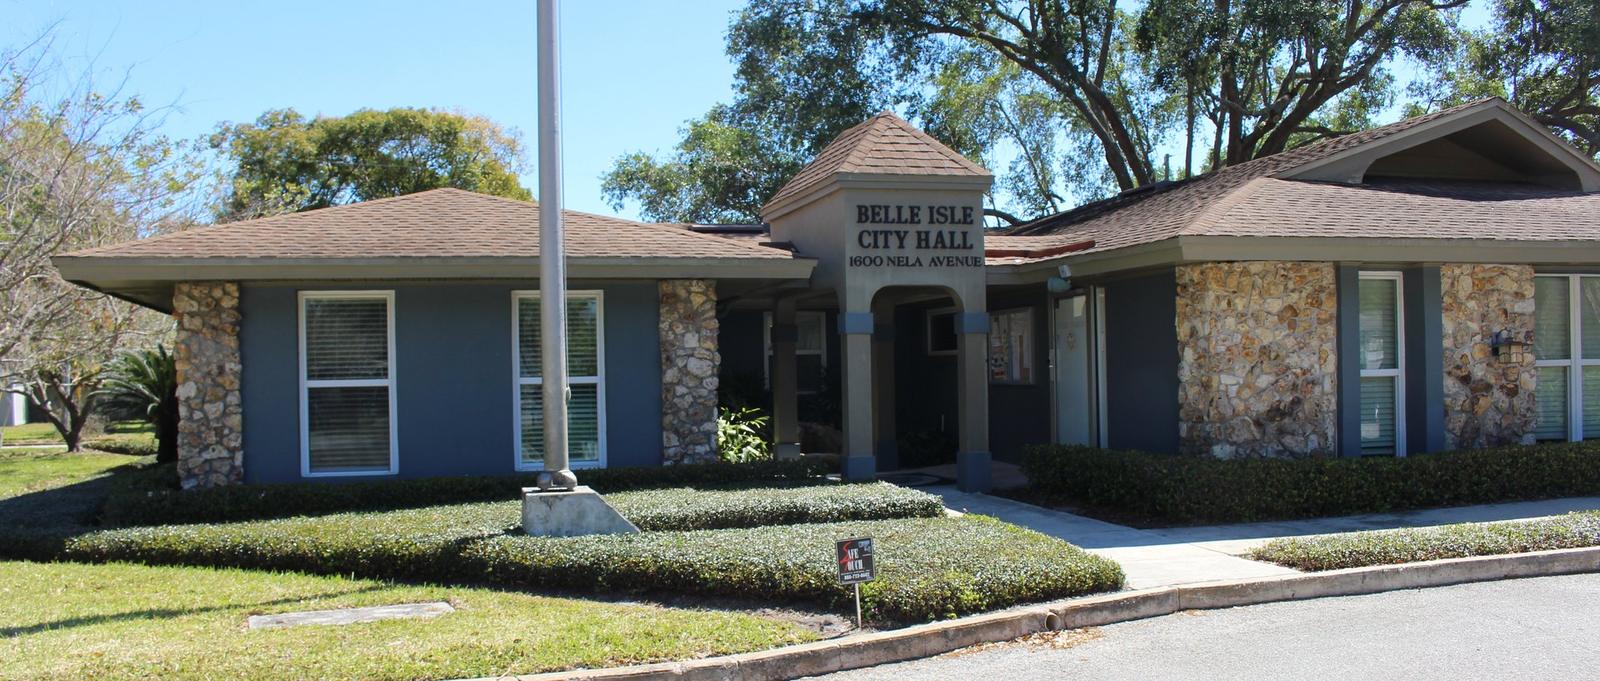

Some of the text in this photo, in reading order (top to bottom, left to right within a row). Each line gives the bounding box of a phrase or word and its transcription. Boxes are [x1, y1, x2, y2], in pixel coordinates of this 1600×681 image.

[856, 204, 974, 225] BELLE ISLE
[857, 229, 974, 250] CITY HALL
[849, 255, 983, 268] 1600 NELA AVENUE
